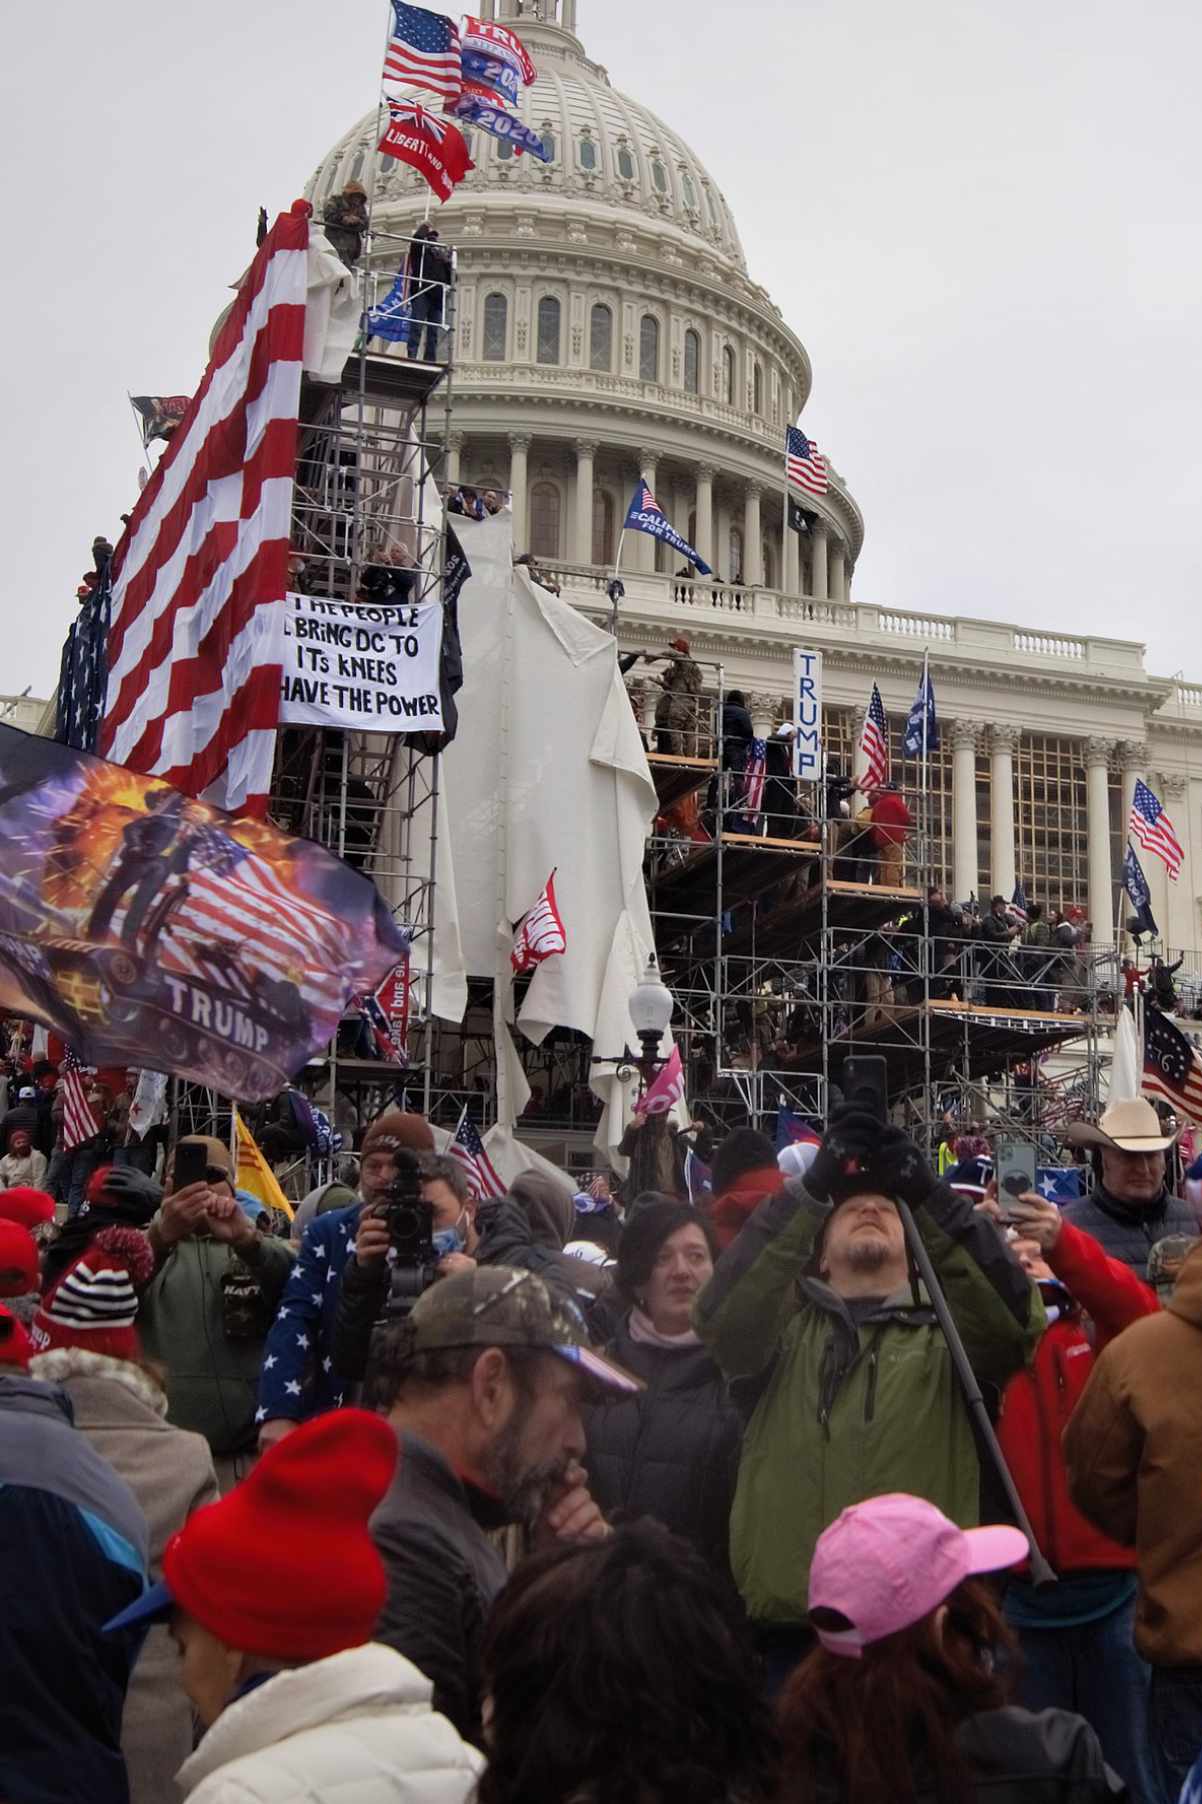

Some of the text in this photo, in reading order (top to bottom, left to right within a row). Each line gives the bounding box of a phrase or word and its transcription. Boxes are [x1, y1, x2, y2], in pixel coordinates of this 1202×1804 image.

[340, 604, 419, 627] PEOPLE
[356, 628, 386, 652] DC
[389, 635, 419, 657] TO
[281, 676, 440, 716] HAVE THE POWER
[799, 654, 819, 776] TRUMP
[163, 974, 269, 1053] TRUMP
